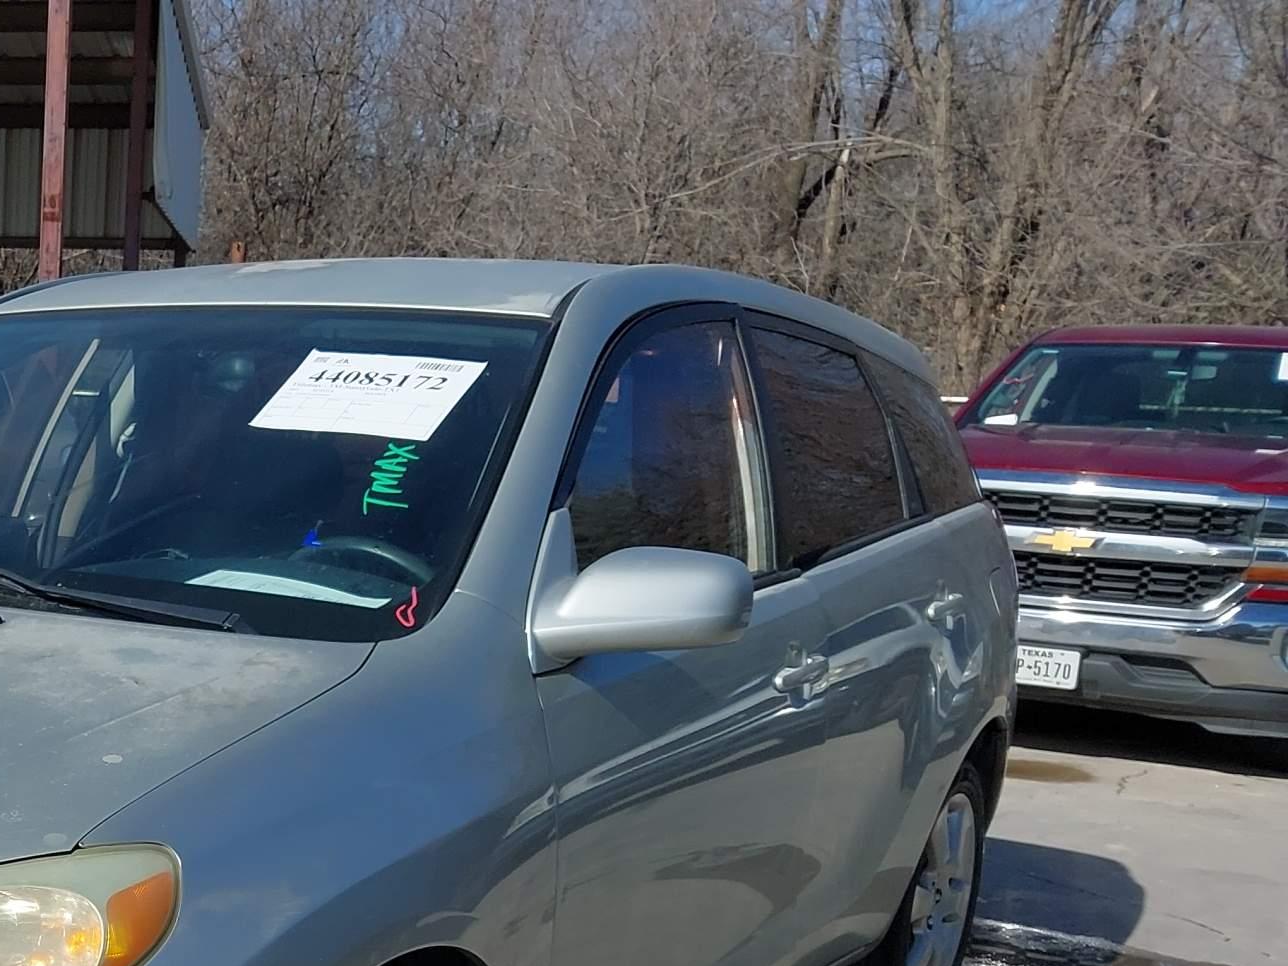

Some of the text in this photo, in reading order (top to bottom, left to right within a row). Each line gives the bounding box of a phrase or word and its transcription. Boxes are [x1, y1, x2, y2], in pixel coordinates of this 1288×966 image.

[308, 369, 449, 392] 44085172
[362, 441, 420, 516] TMAX
[1022, 649, 1054, 659] TEXAS
